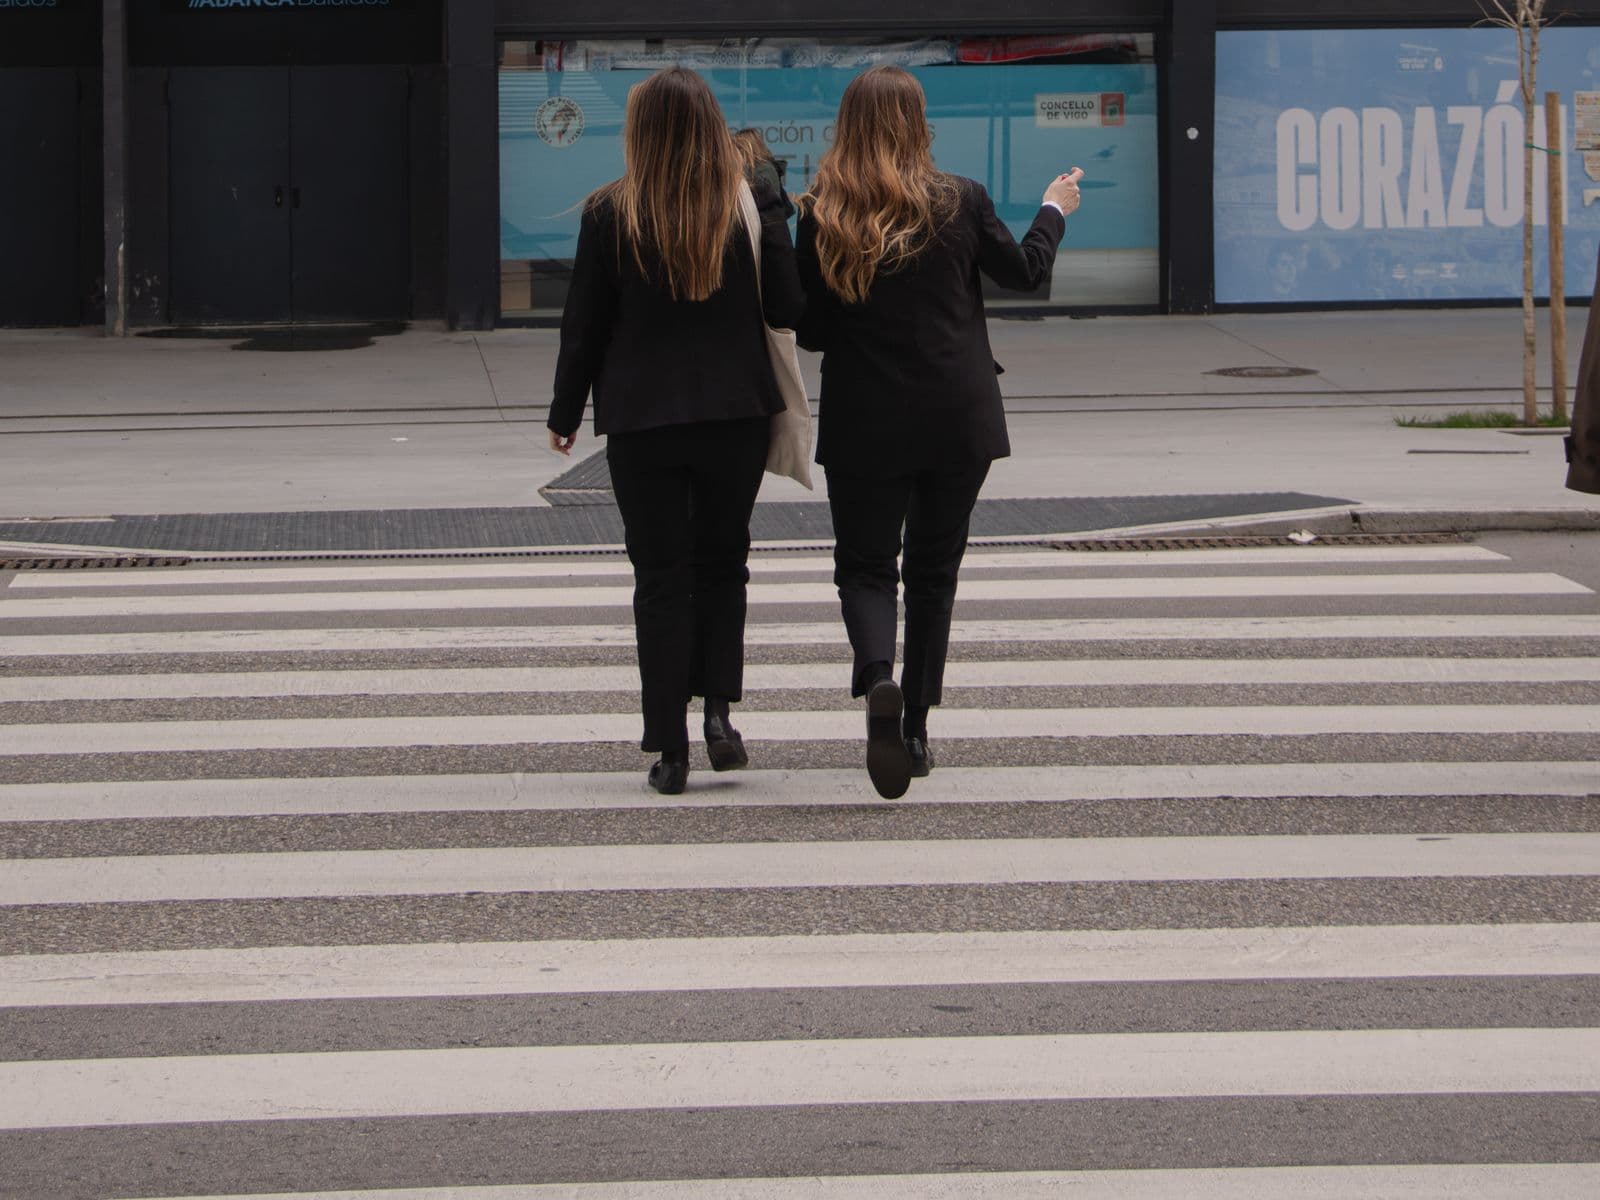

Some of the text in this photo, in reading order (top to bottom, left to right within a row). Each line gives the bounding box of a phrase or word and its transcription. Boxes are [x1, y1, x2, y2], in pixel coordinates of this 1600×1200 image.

[1040, 100, 1095, 110] CONCELLO
[1046, 111, 1089, 120] DE VIGO
